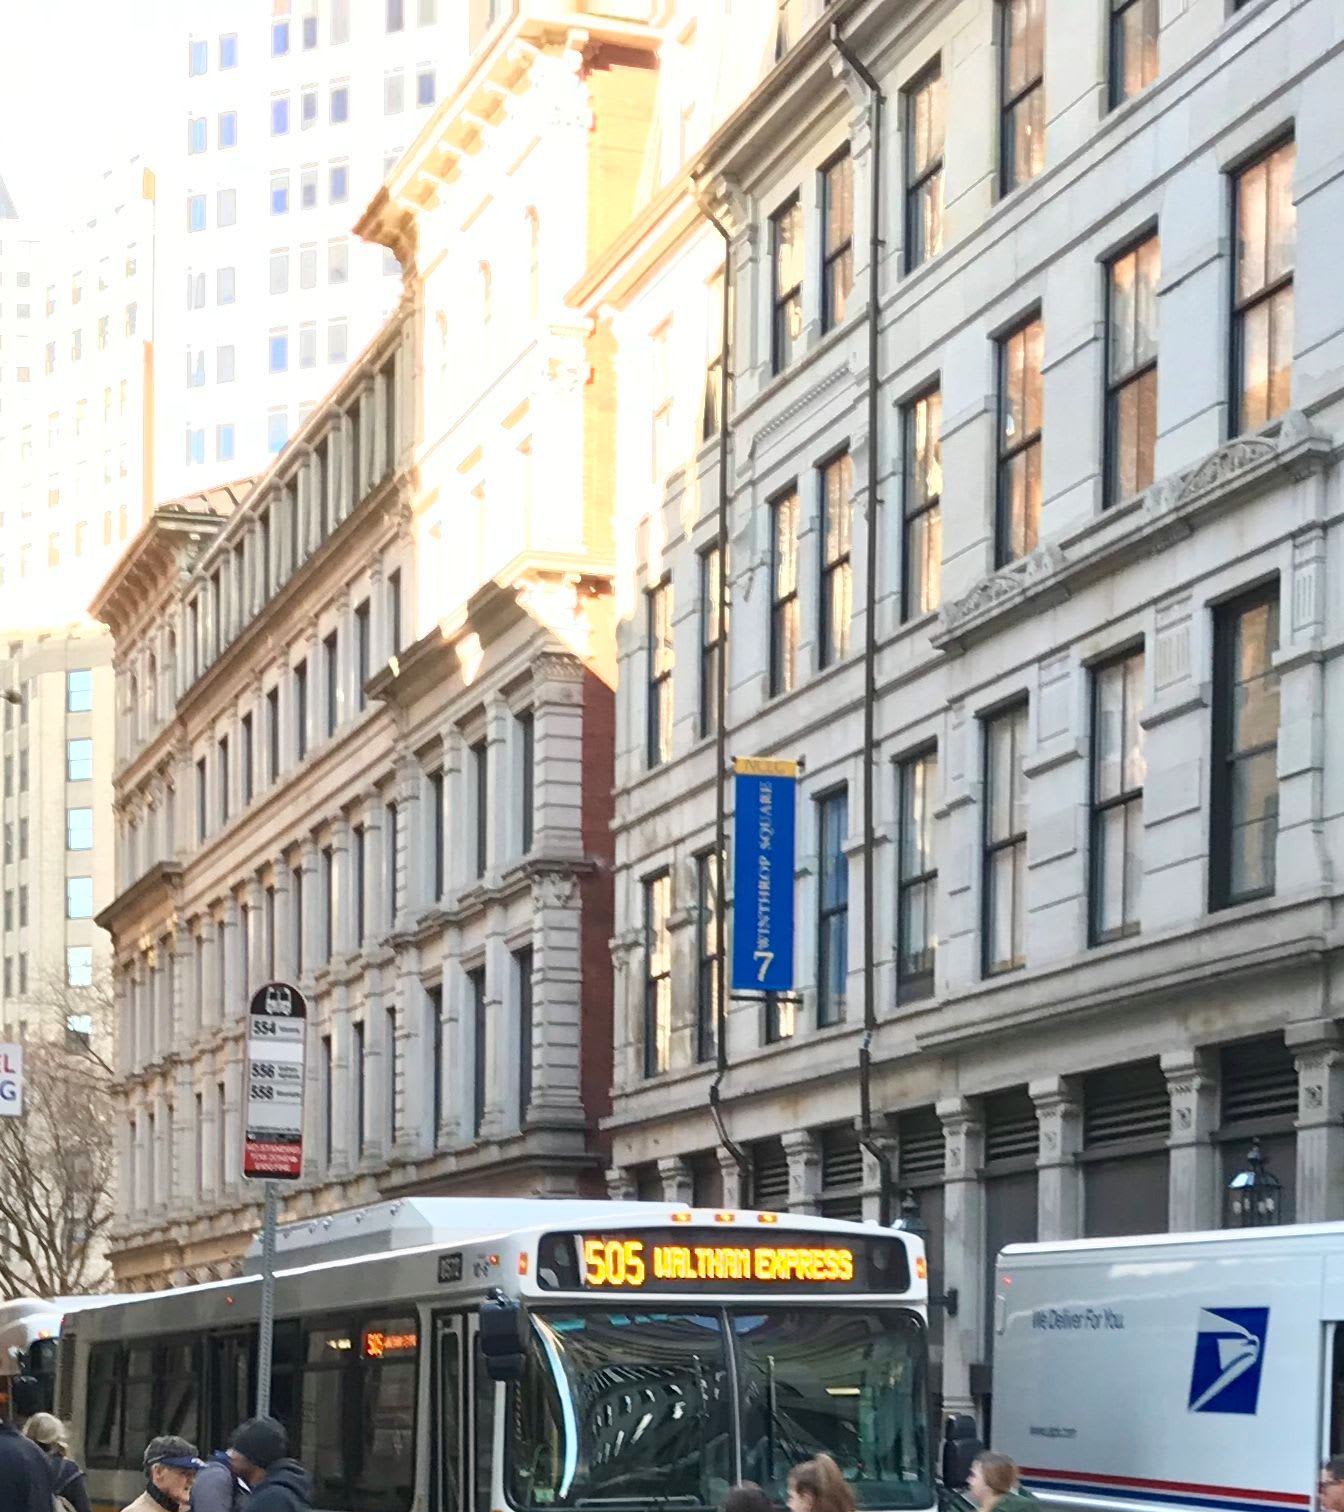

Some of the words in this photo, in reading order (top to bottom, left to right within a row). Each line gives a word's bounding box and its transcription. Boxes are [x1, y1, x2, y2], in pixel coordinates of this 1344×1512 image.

[759, 780, 774, 850] SQUARE
[756, 855, 771, 950] WINTHROP
[753, 951, 774, 982] 7
[253, 1021, 276, 1036] 554
[583, 1240, 645, 1286] 505
[653, 1246, 751, 1280] WALTHAM
[754, 1247, 854, 1281] EXPRESS
[1032, 1309, 1047, 1329] We
[1048, 1308, 1084, 1330] Deliver
[1085, 1308, 1102, 1330] For
